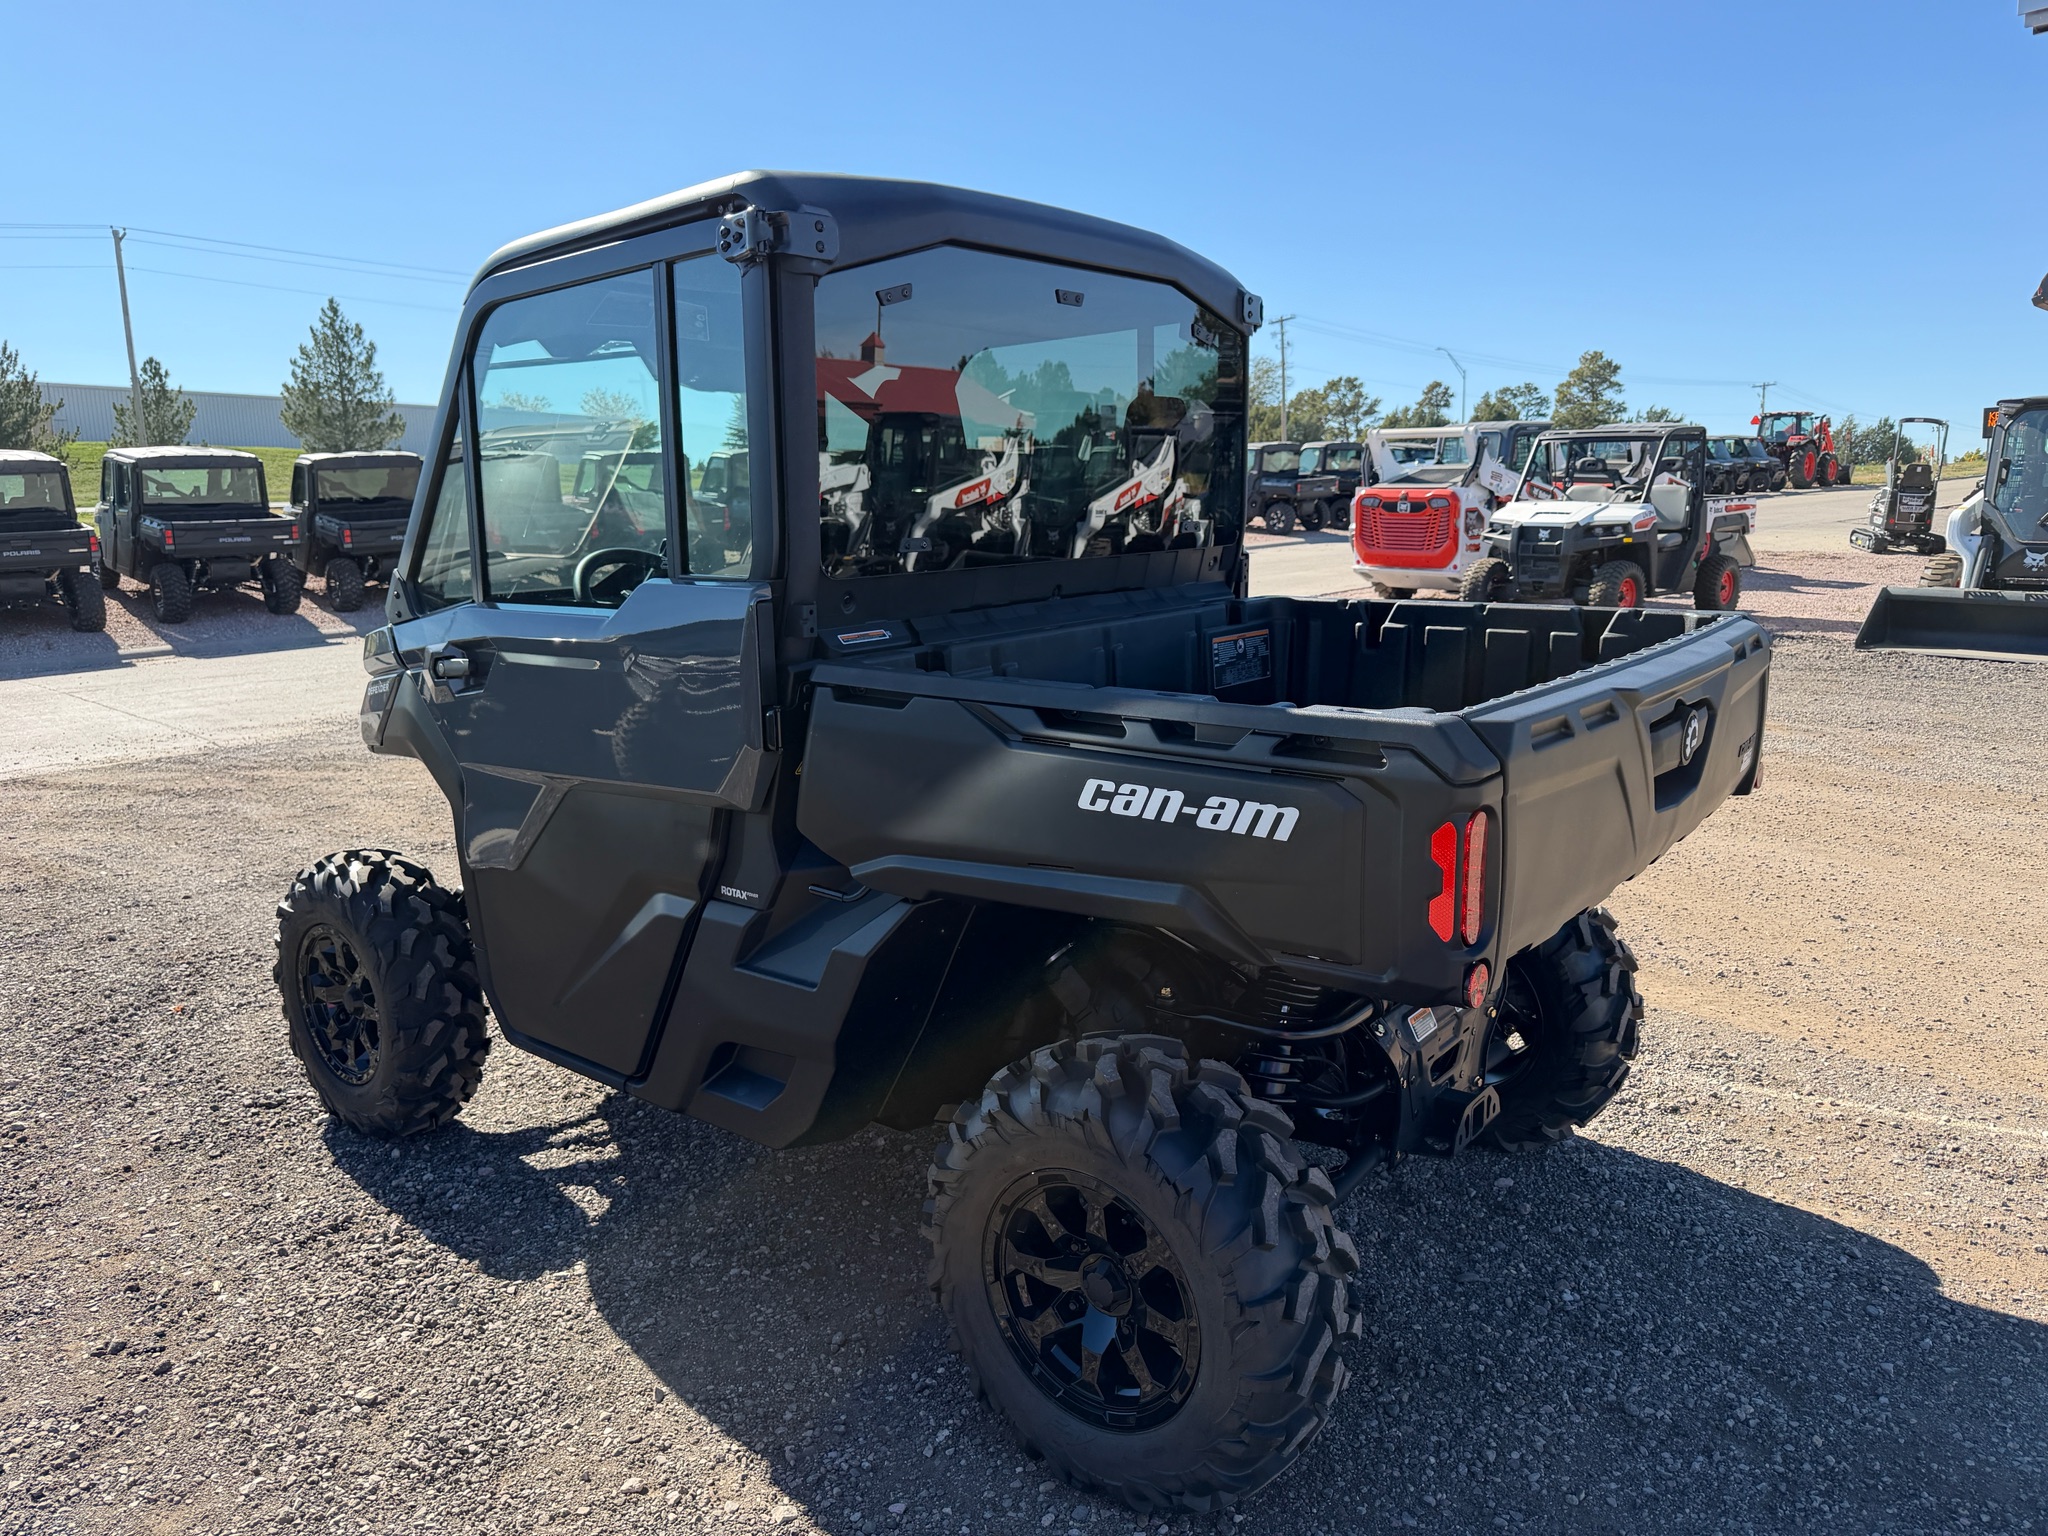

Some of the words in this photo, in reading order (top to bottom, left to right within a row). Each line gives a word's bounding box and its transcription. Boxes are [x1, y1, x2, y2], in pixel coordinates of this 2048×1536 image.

[2, 549, 41, 557] POLARIS
[1078, 778, 1300, 842] can-am
[720, 885, 747, 900] ROTAX
